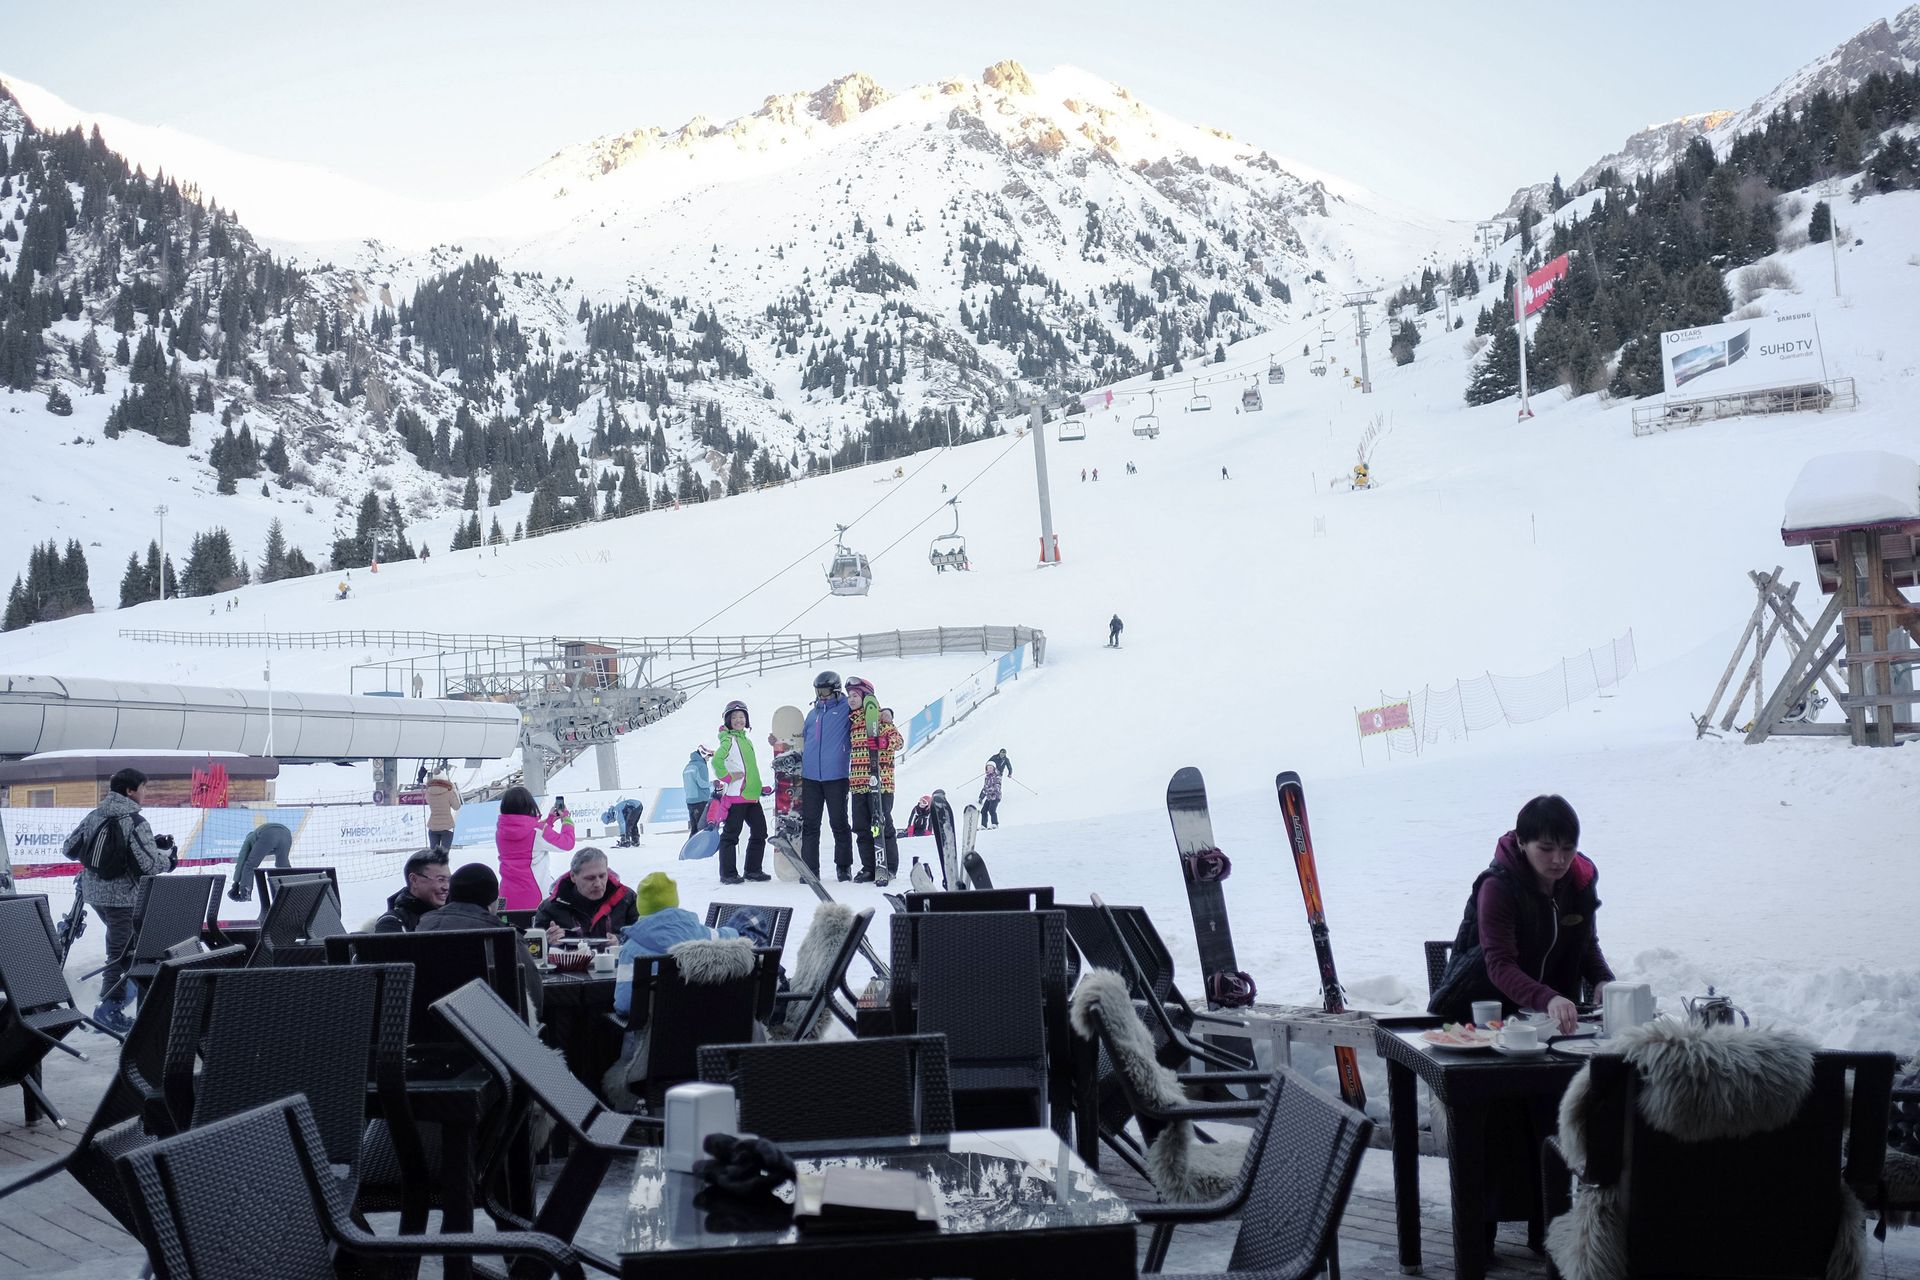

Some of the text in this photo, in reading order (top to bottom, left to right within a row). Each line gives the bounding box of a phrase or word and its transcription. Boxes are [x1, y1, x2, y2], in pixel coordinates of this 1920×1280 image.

[1777, 312, 1811, 323] SAMSUNG
[1666, 333, 1680, 344] 10
[1680, 329, 1702, 337] YEARS
[1760, 339, 1812, 356] SUHD TV
